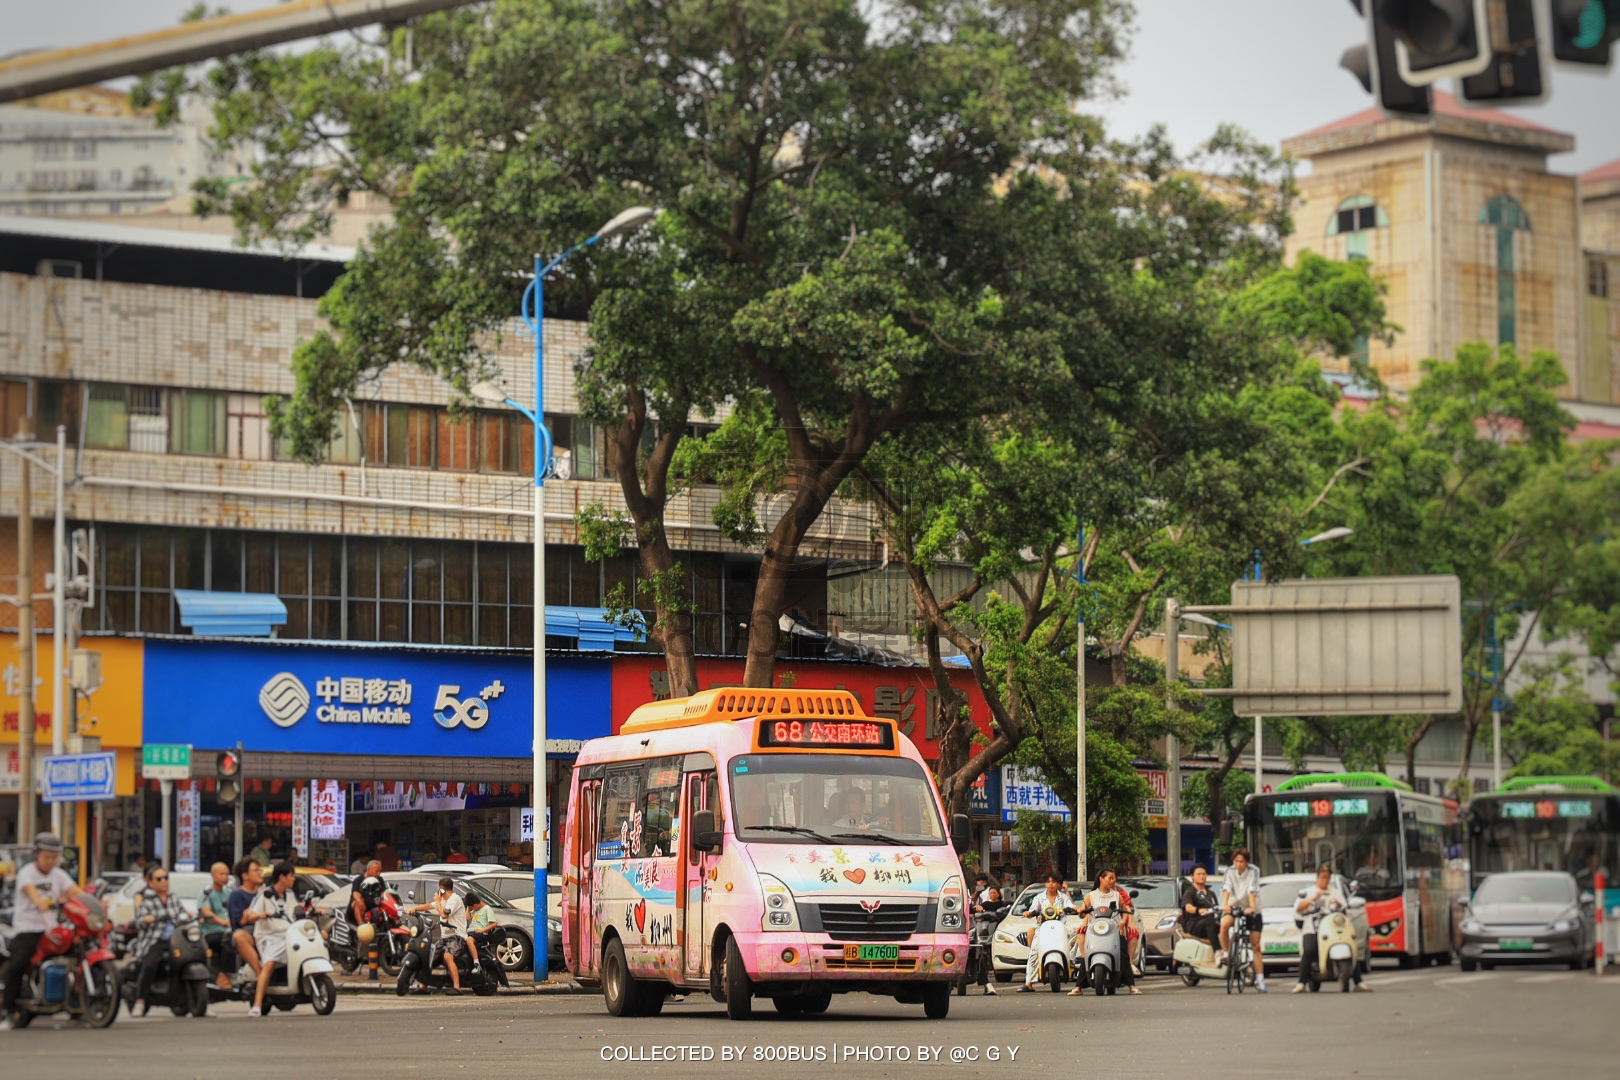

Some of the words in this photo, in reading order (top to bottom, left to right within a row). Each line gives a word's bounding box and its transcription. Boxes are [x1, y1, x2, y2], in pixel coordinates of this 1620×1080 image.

[316, 676, 413, 706] 中国移动
[317, 706, 361, 724] China
[362, 707, 412, 725] Mobile
[773, 720, 804, 743] 68
[809, 722, 881, 745] 公交南环站
[1005, 785, 1067, 806] 西就手机
[1312, 799, 1331, 816] 19
[178, 791, 193, 860] 机维修点
[818, 867, 838, 884] 我
[873, 868, 912, 884] 柳州
